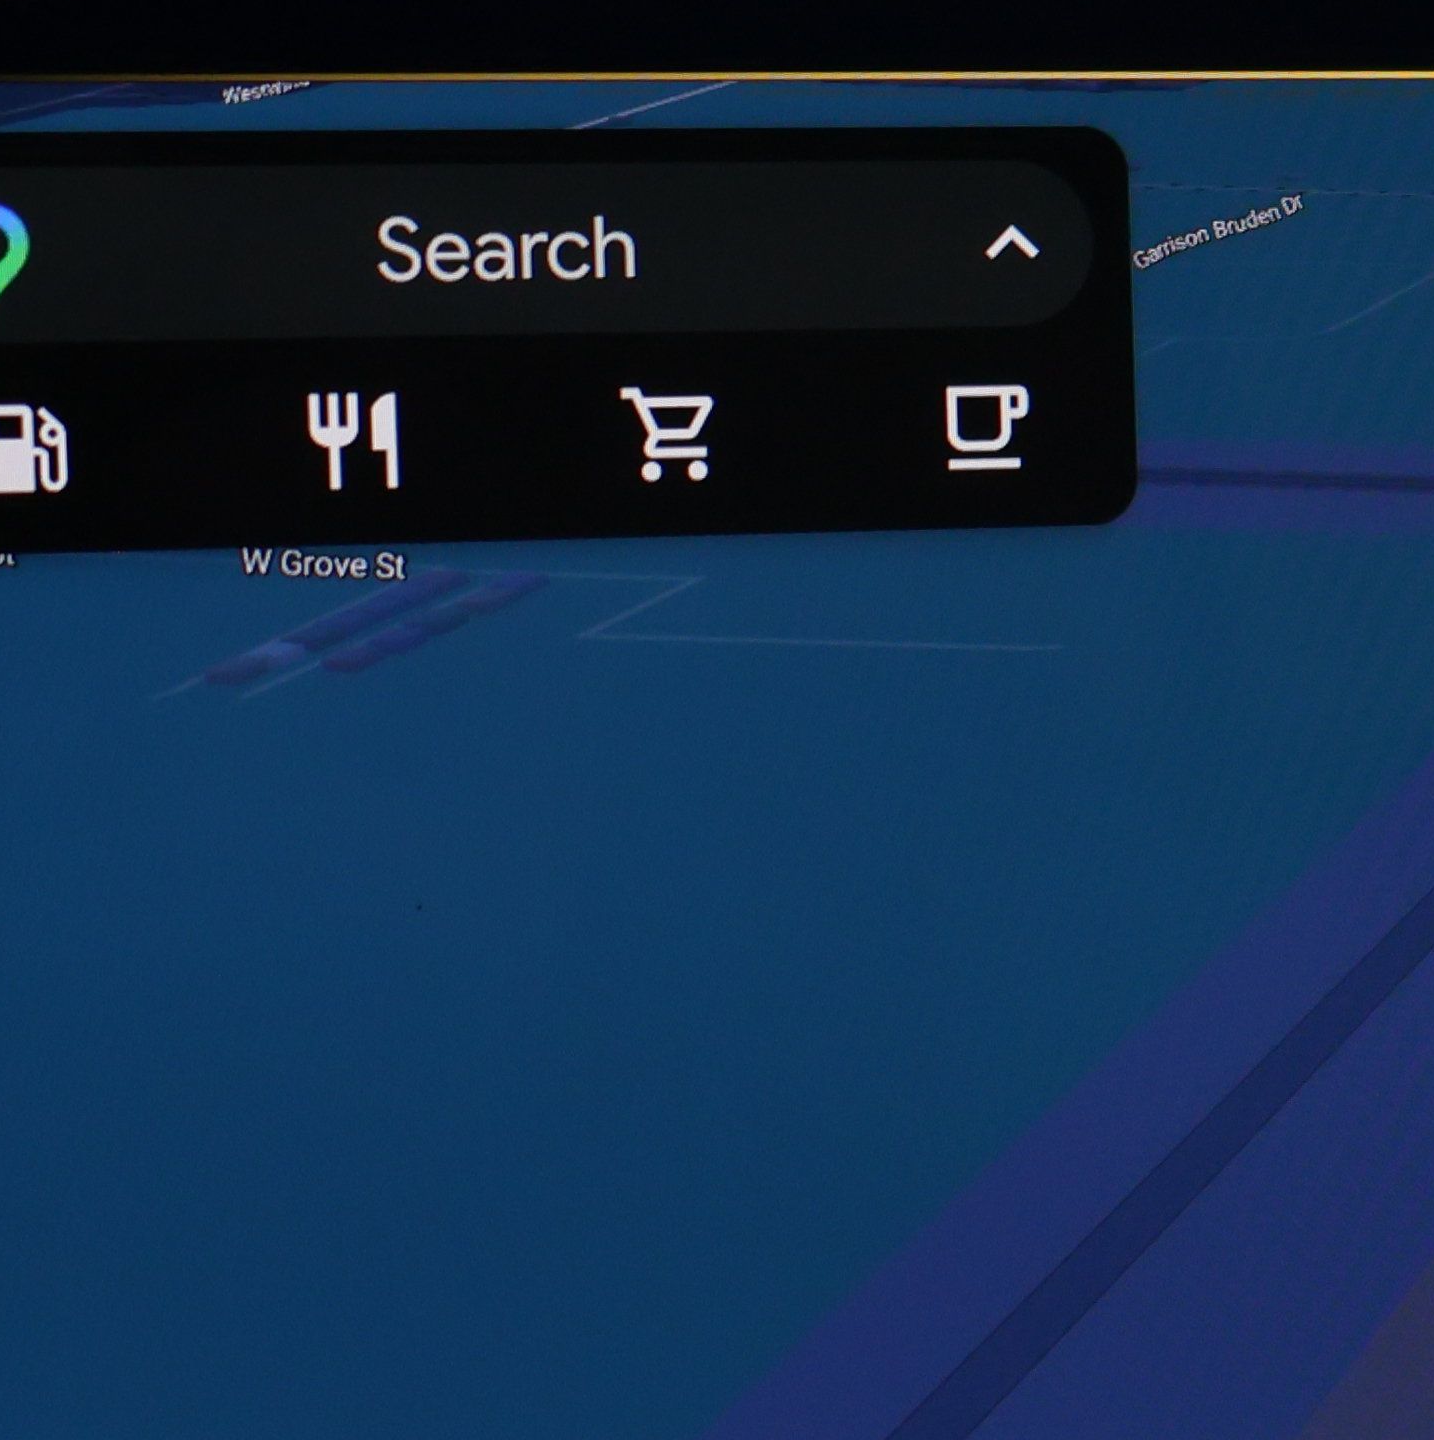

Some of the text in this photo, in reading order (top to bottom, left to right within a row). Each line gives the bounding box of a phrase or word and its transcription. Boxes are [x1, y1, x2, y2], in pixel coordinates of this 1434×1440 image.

[377, 216, 636, 282] Search
[1133, 193, 1304, 270] Garrison Bruden Dr
[241, 547, 406, 581] W Grove St
